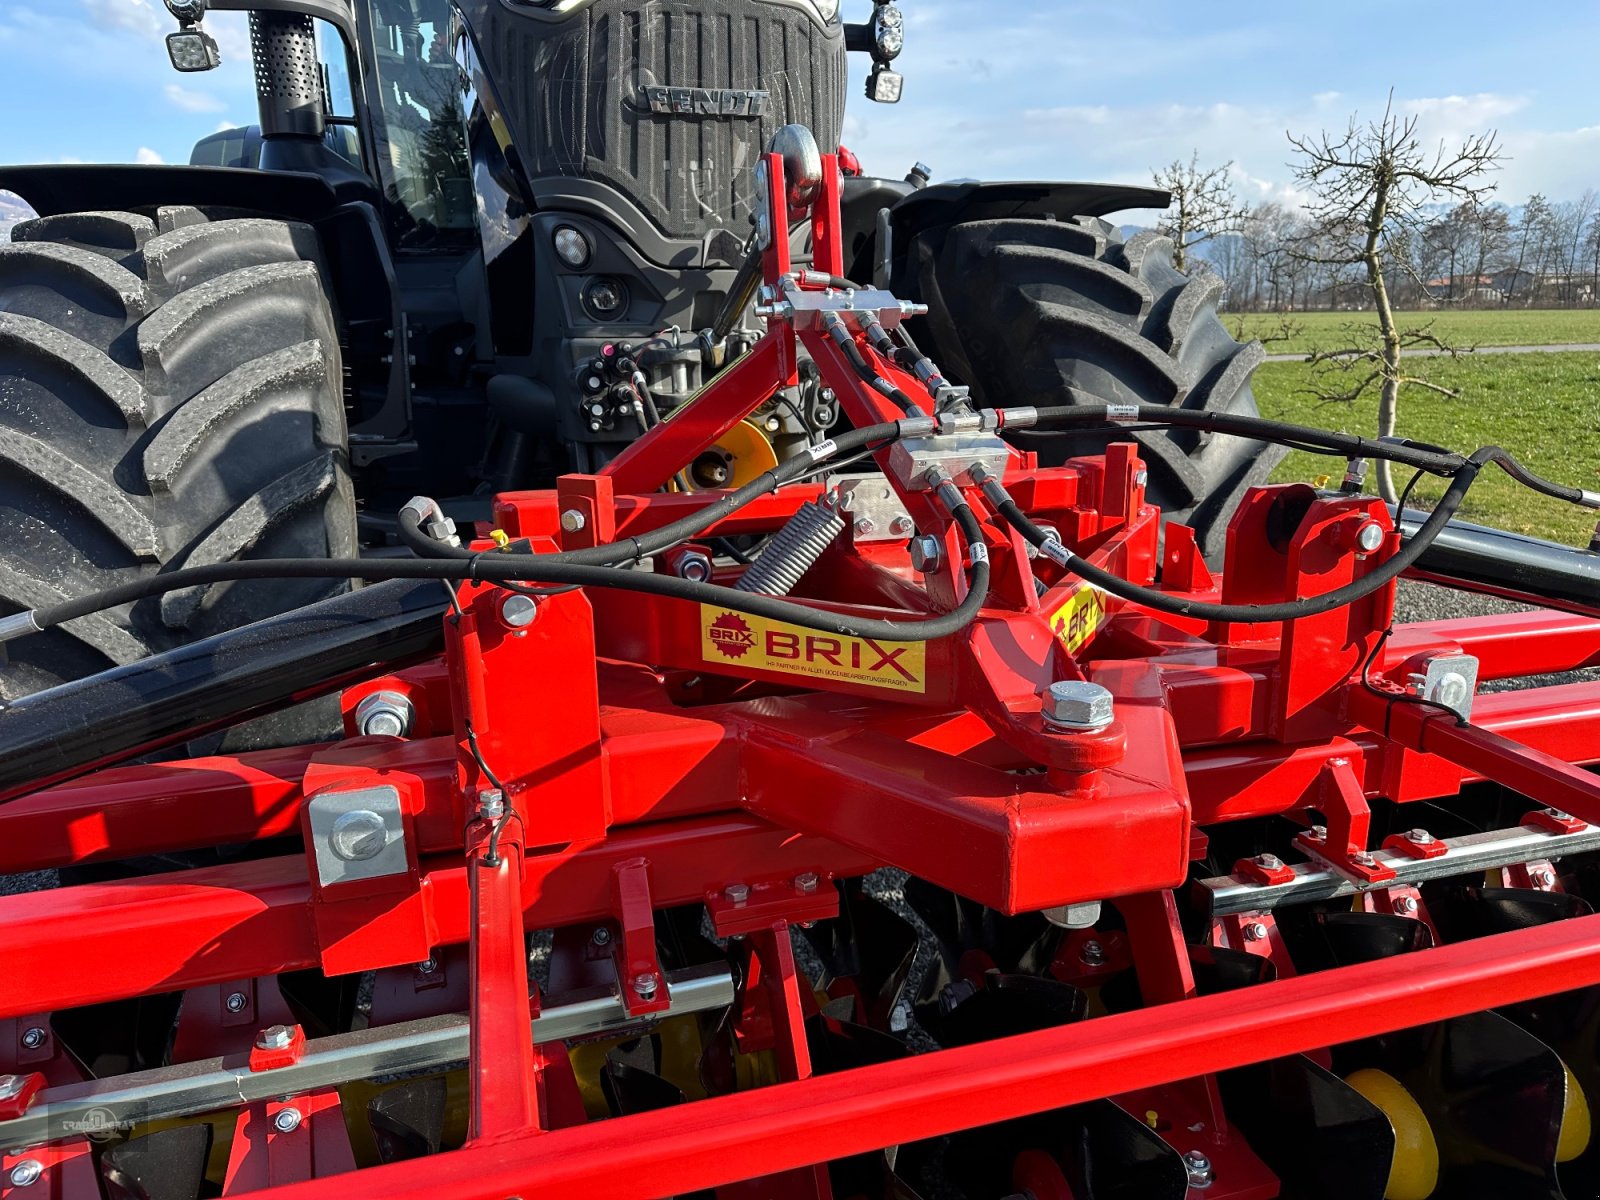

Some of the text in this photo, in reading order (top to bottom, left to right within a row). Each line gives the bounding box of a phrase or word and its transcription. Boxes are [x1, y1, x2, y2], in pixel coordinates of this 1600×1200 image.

[642, 85, 769, 115] FENDT
[1069, 587, 1105, 642] BRIX
[709, 627, 757, 647] BRIX
[766, 630, 919, 682] BRIX
